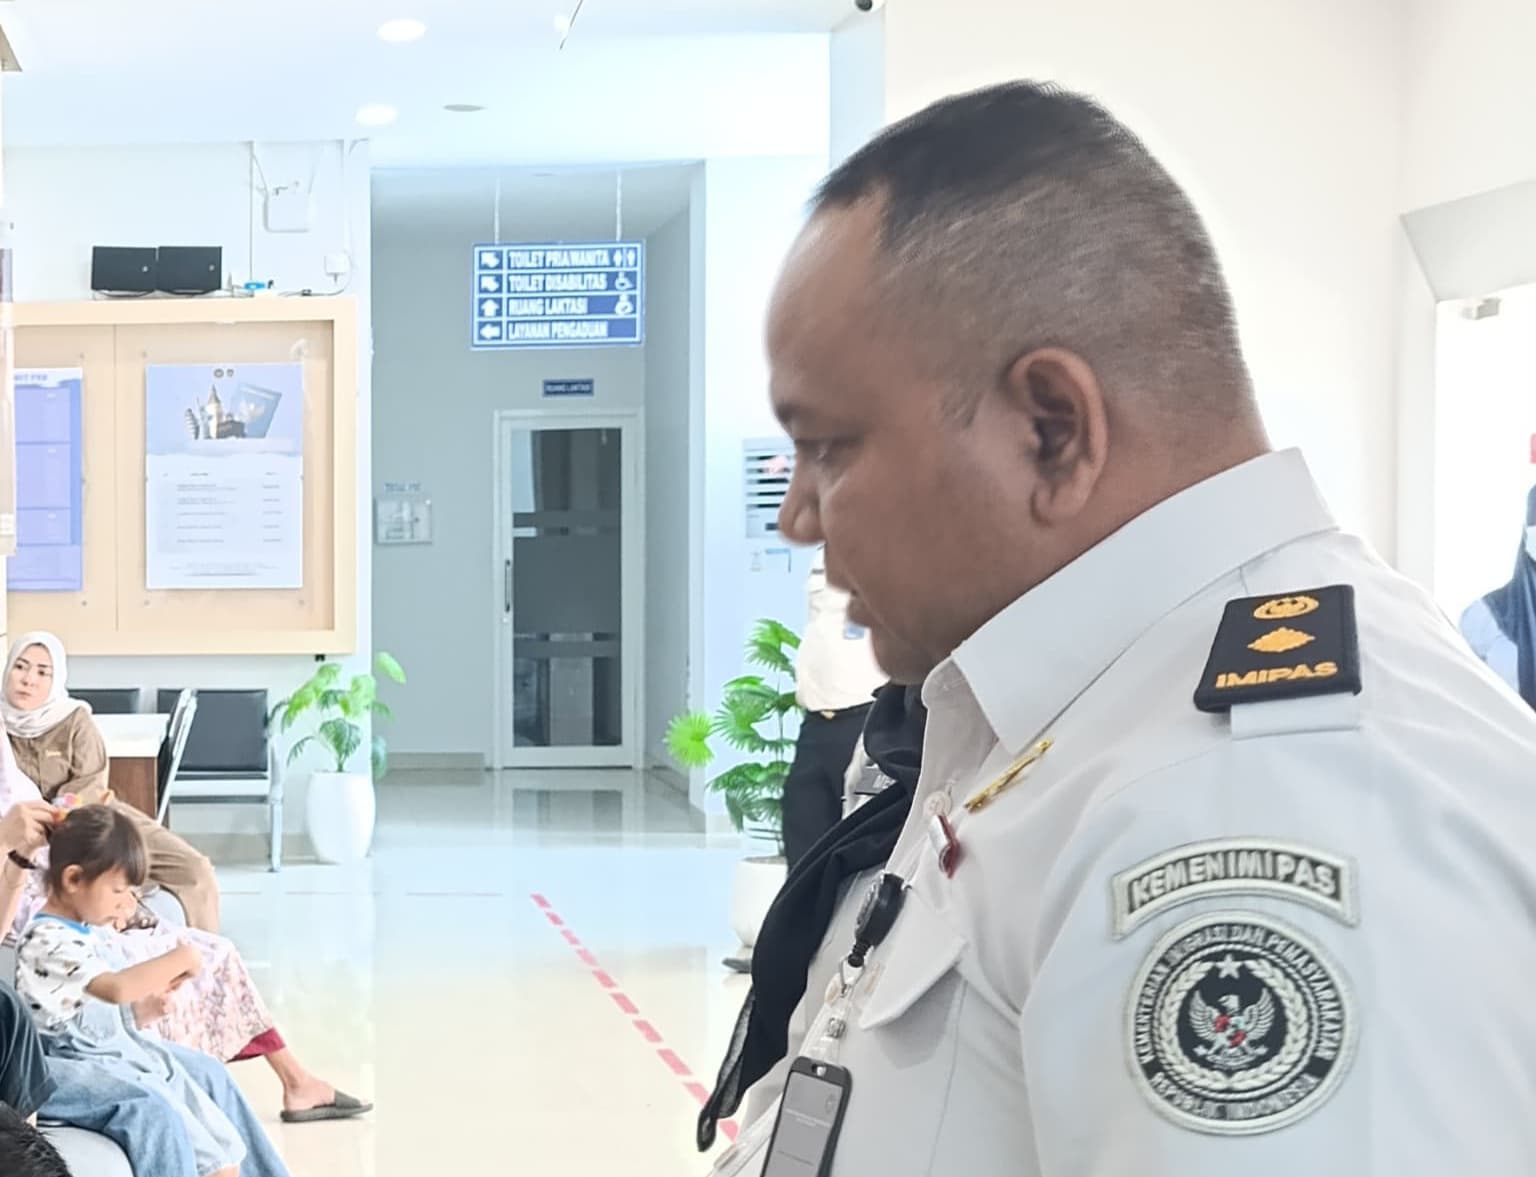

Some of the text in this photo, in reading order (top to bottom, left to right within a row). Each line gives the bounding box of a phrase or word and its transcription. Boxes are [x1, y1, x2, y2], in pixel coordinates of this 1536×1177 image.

[509, 250, 544, 268] TOILET
[509, 273, 607, 292] TOILET DISABILITAS
[509, 297, 588, 316] RUANG LAKTASI
[509, 322, 550, 340] LAYANAN
[1216, 662, 1338, 688] IMIPAS
[1130, 849, 1338, 906] KEMENIMIPAS
[1231, 924, 1266, 945] DAN
